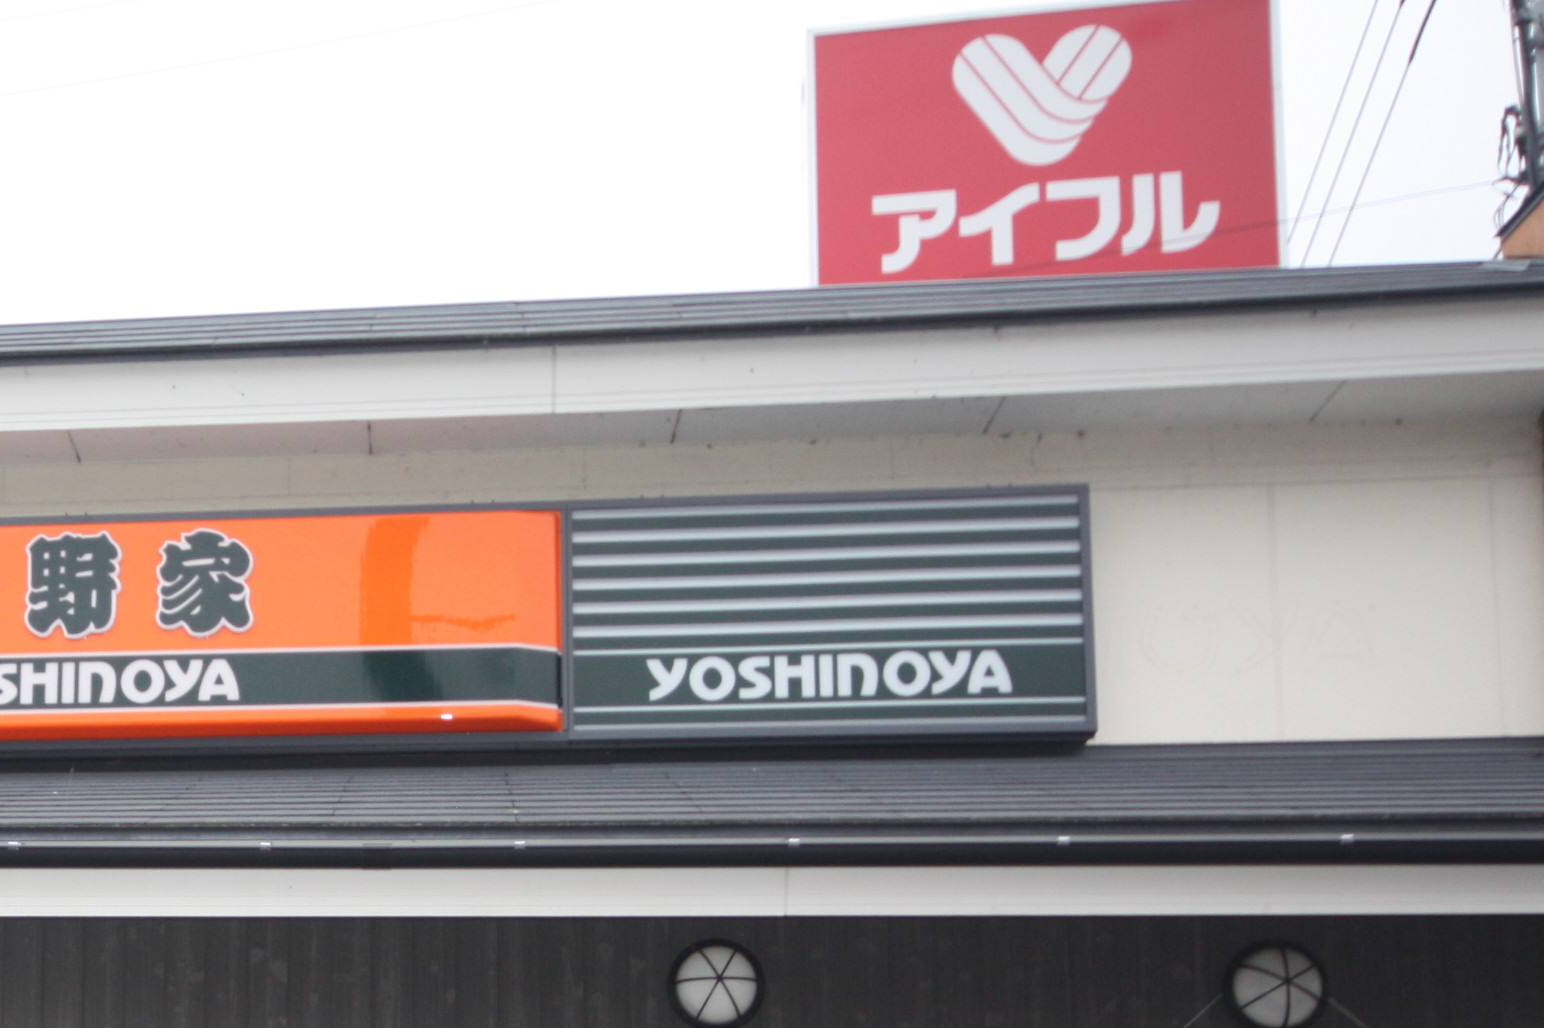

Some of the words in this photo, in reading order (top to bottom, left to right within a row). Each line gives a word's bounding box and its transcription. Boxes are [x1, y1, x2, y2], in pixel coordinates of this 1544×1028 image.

[871, 170, 1221, 275] アイフル
[646, 649, 1014, 703] YOSHINOYA
